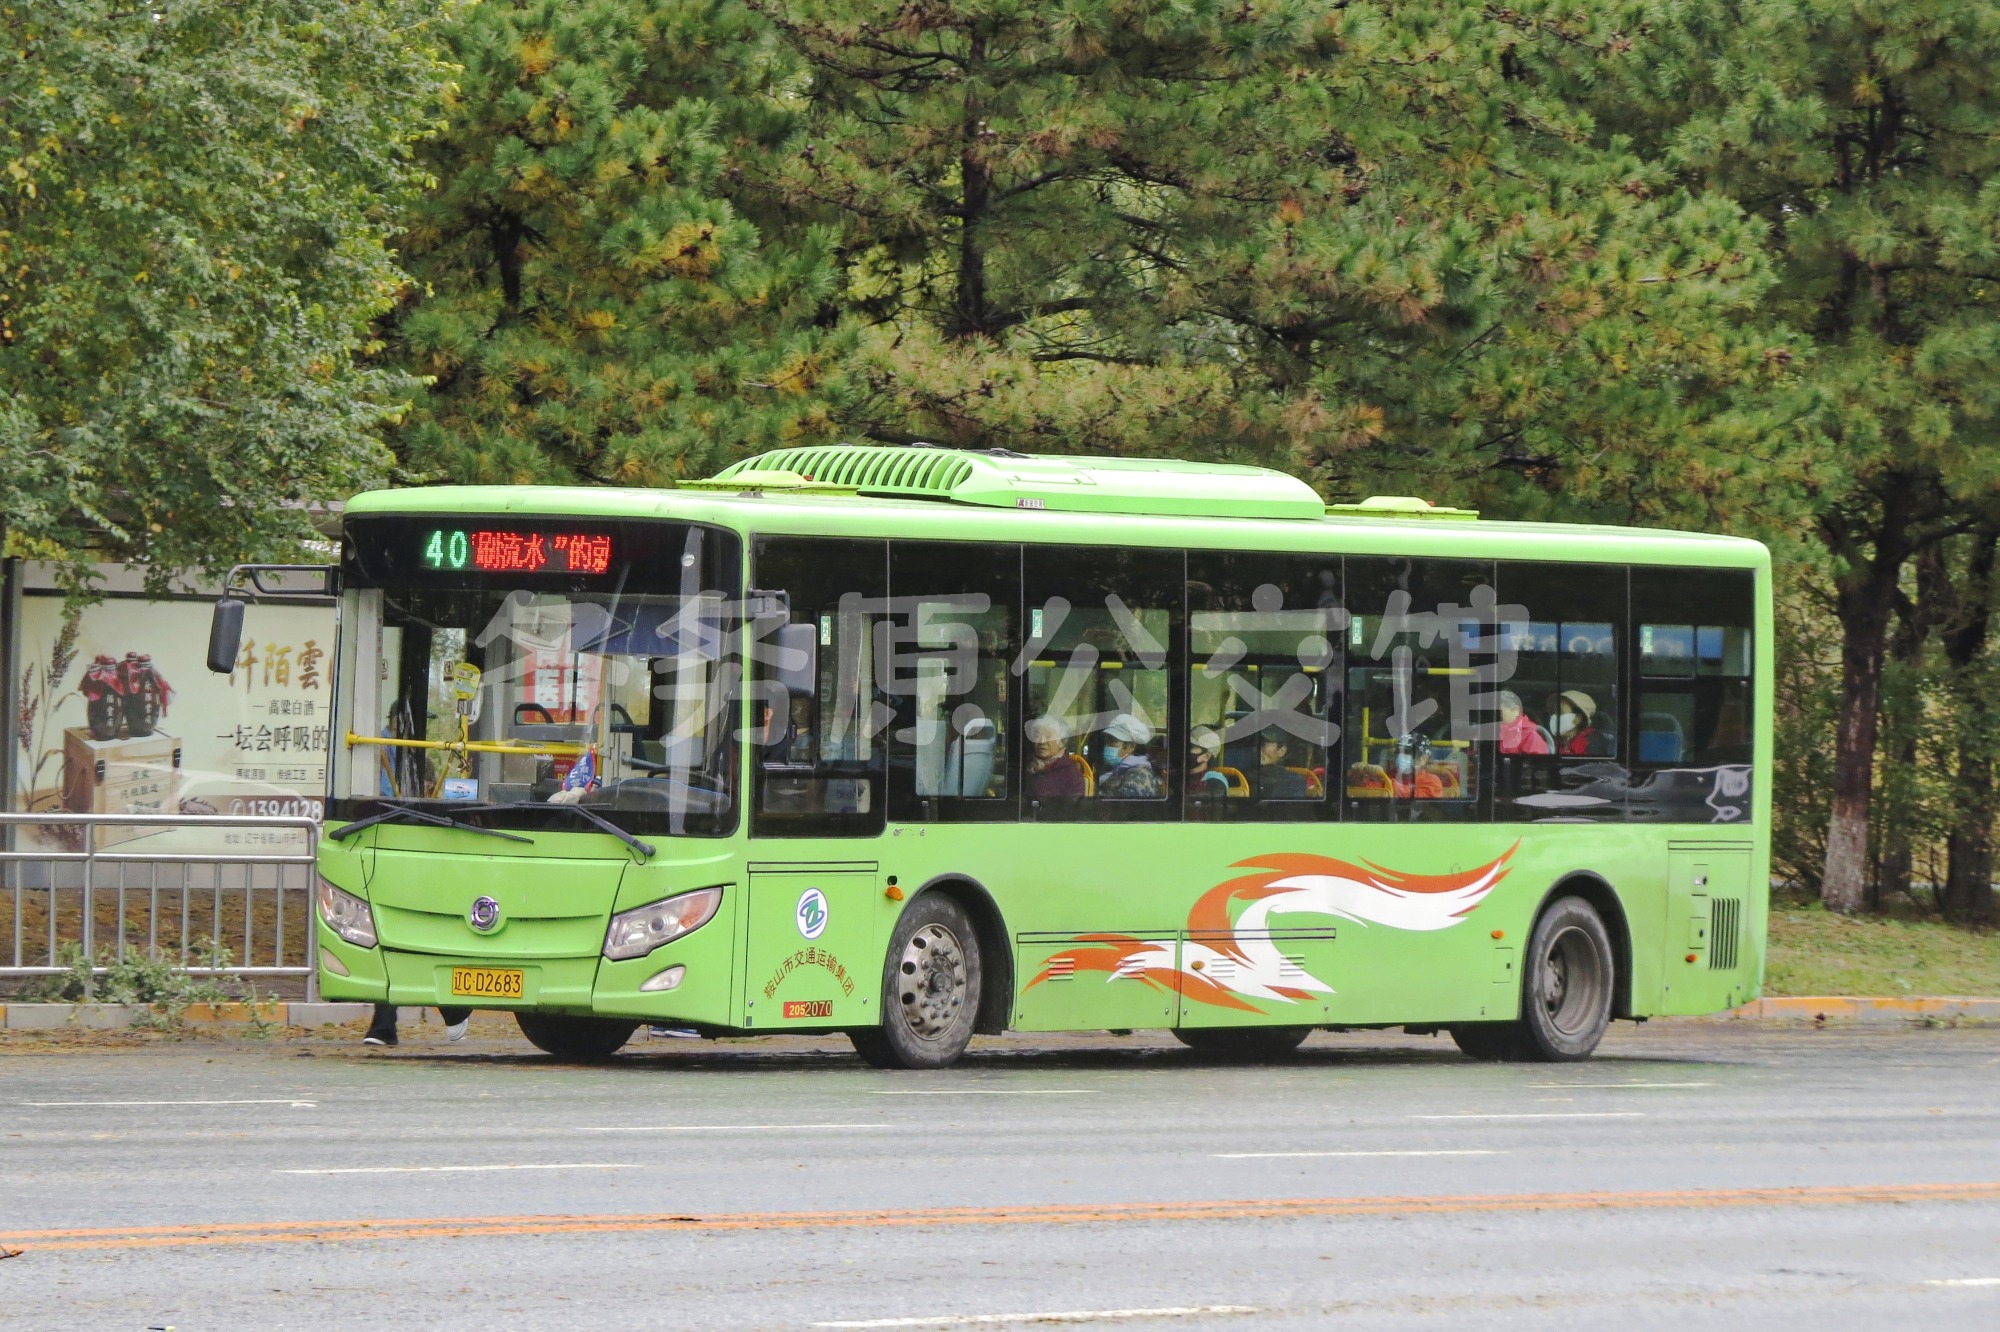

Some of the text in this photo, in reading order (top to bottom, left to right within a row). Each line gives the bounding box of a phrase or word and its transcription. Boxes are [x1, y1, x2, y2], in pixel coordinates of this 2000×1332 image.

[427, 530, 467, 568] 40
[229, 639, 333, 694] 阡陌雲
[216, 724, 328, 752] 一坛会呼吸的
[248, 800, 323, 823] 1394128
[764, 947, 855, 999] 鞍山市交通运输集团
